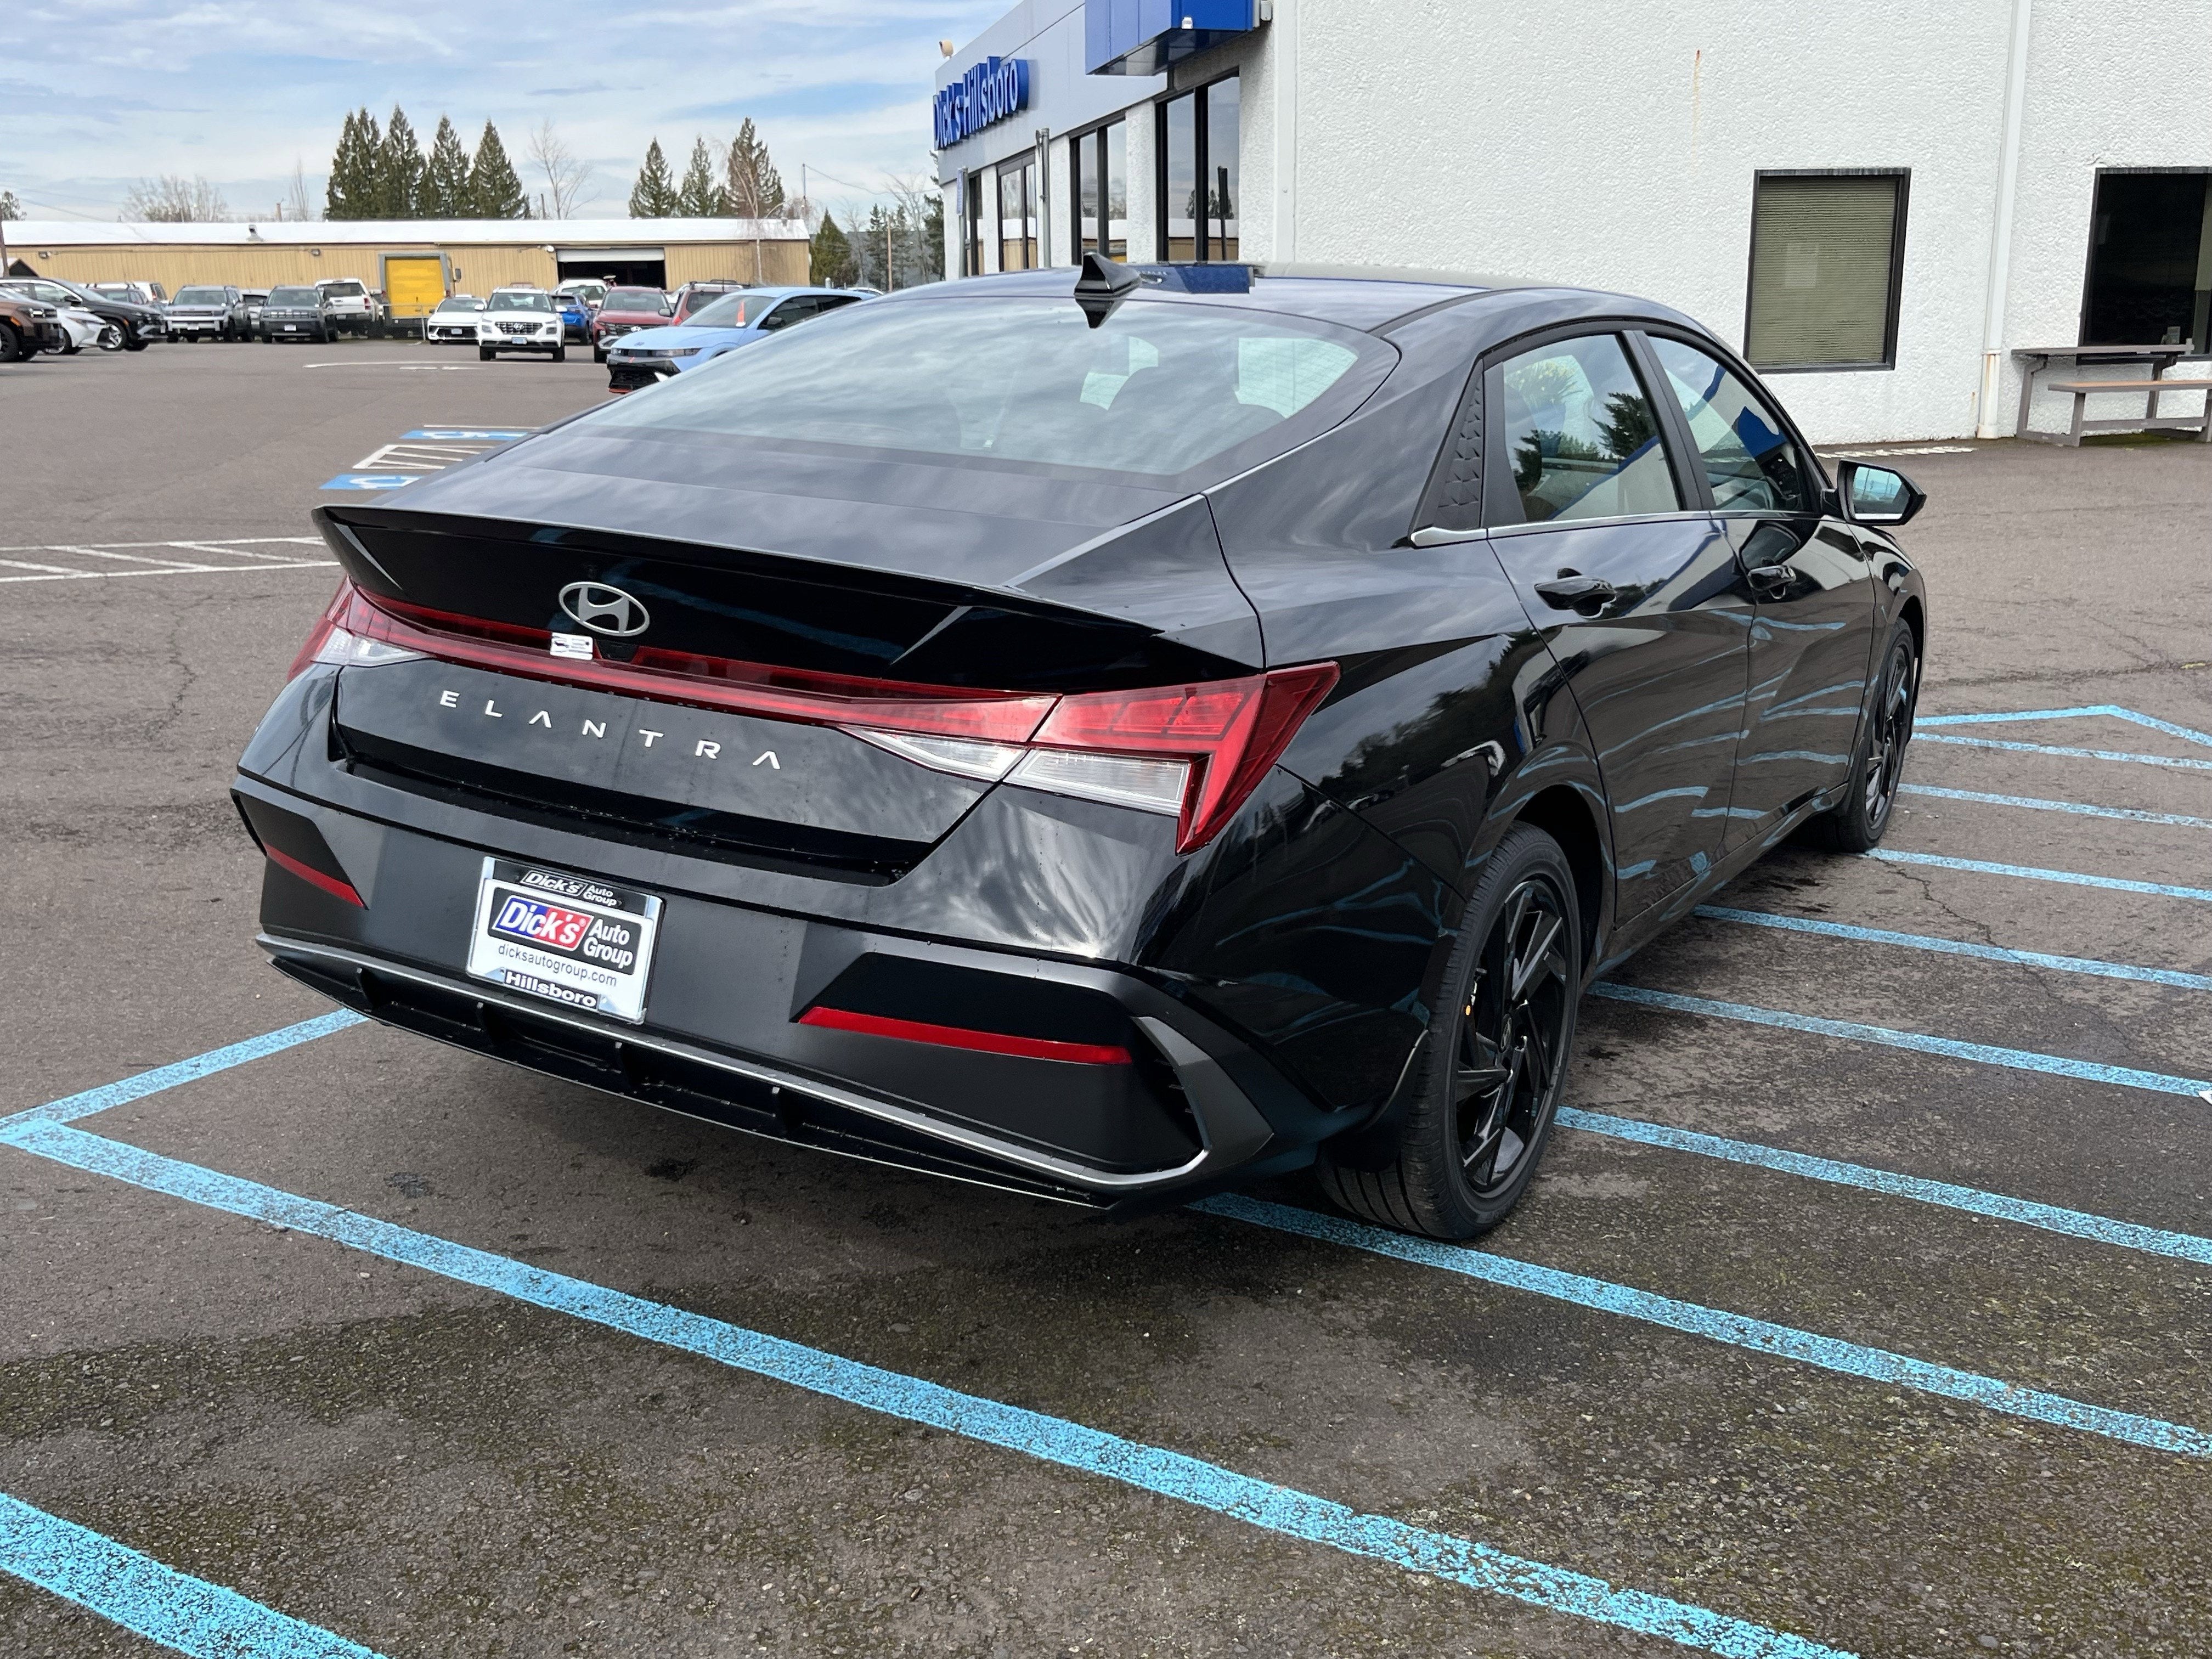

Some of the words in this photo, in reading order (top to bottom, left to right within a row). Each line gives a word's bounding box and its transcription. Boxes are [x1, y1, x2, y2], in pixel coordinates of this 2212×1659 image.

[933, 83, 961, 150] Dick's
[963, 57, 1025, 136] Hillsboro
[439, 690, 781, 770] ELANTRA
[526, 872, 582, 895] Dick's
[583, 891, 618, 907] Group
[588, 884, 613, 898] Auto
[589, 918, 630, 946] Auto
[498, 943, 618, 988] dicksautogroup.com
[583, 938, 634, 969] Group
[505, 971, 597, 1007] Hillsboro
